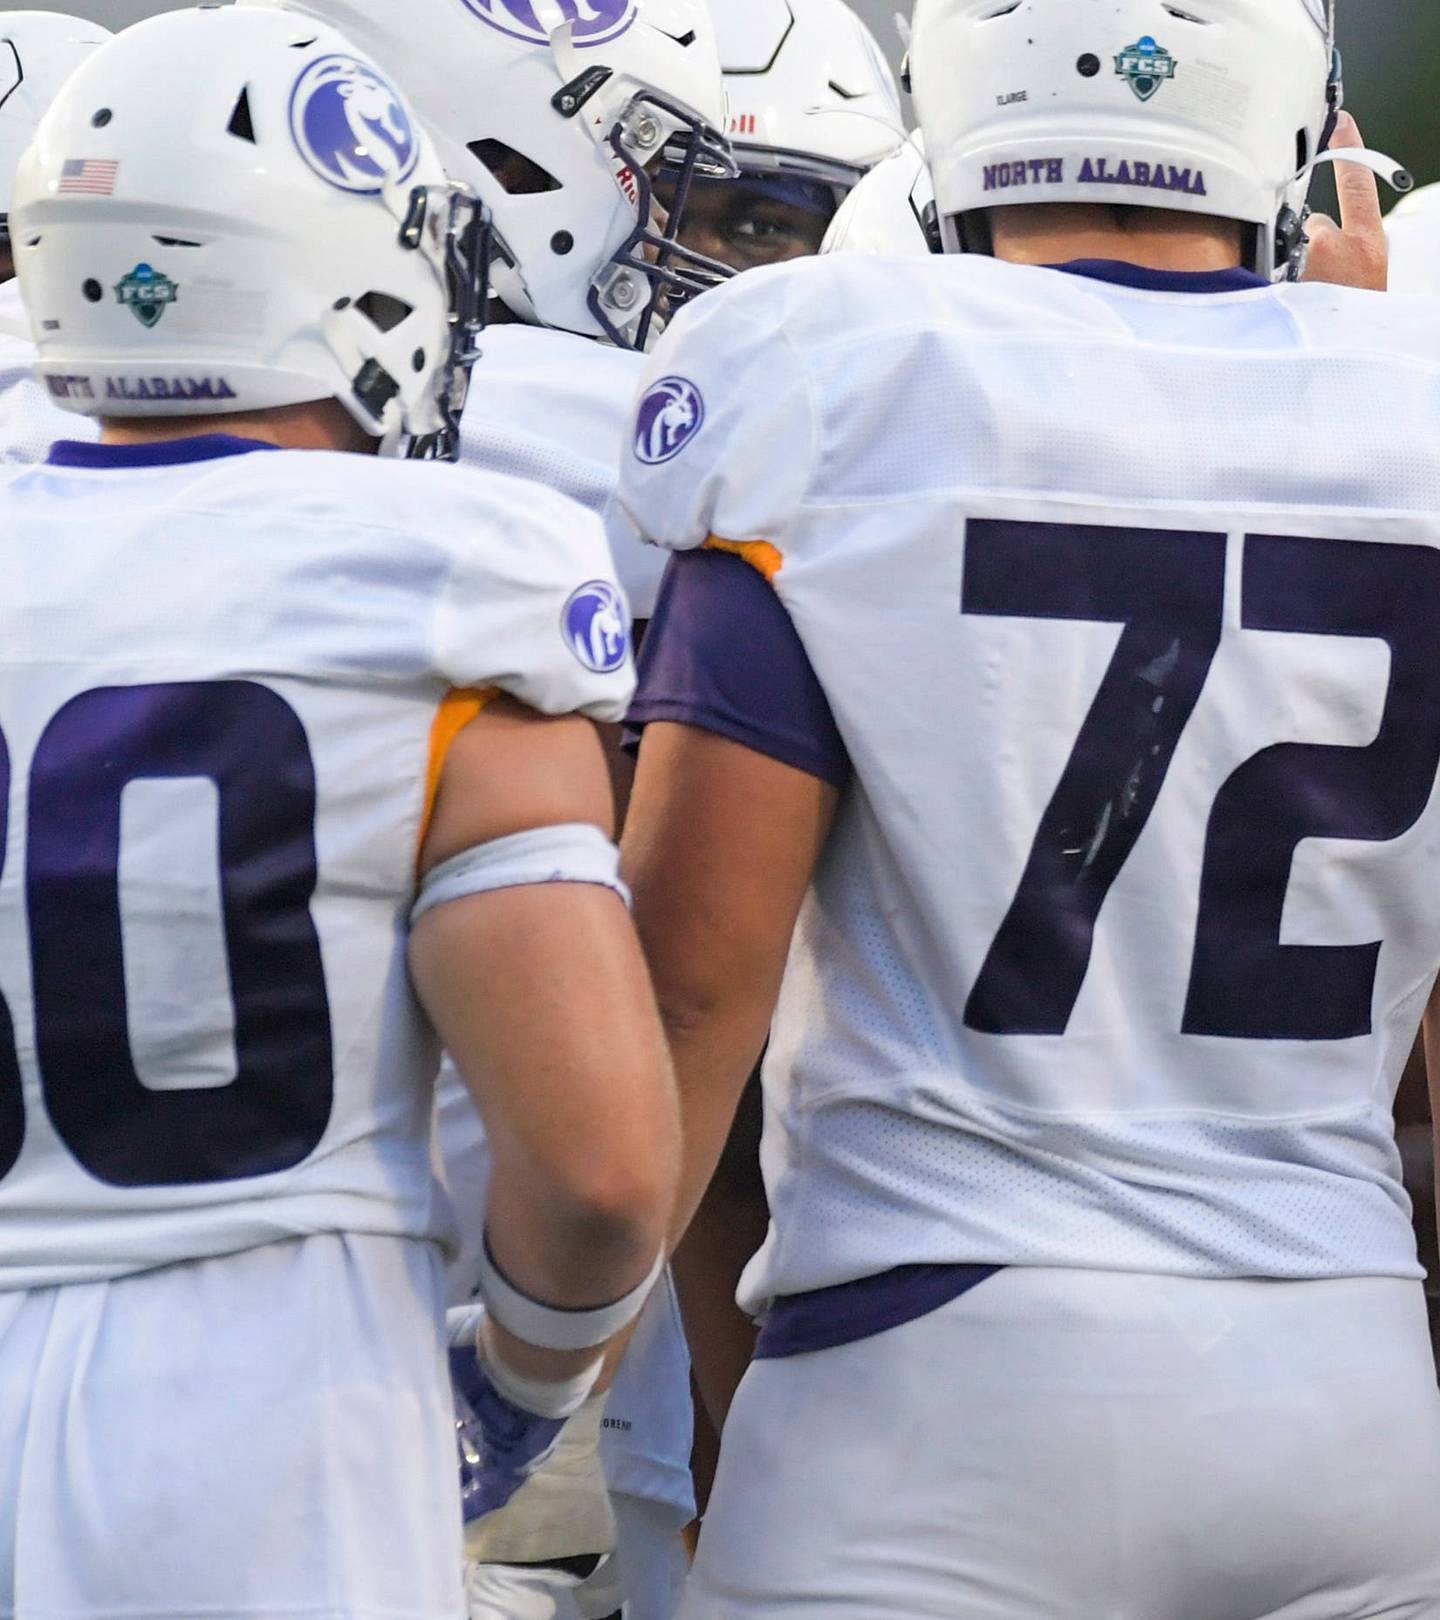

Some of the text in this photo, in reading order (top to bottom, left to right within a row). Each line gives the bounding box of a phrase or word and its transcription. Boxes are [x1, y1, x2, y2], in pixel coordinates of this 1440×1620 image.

[1121, 57, 1169, 73] FCS
[983, 158, 1207, 195] NORTH ALABAMA
[122, 286, 170, 299] FCS
[105, 377, 237, 400] ALABAMA
[0, 680, 334, 1190] 0
